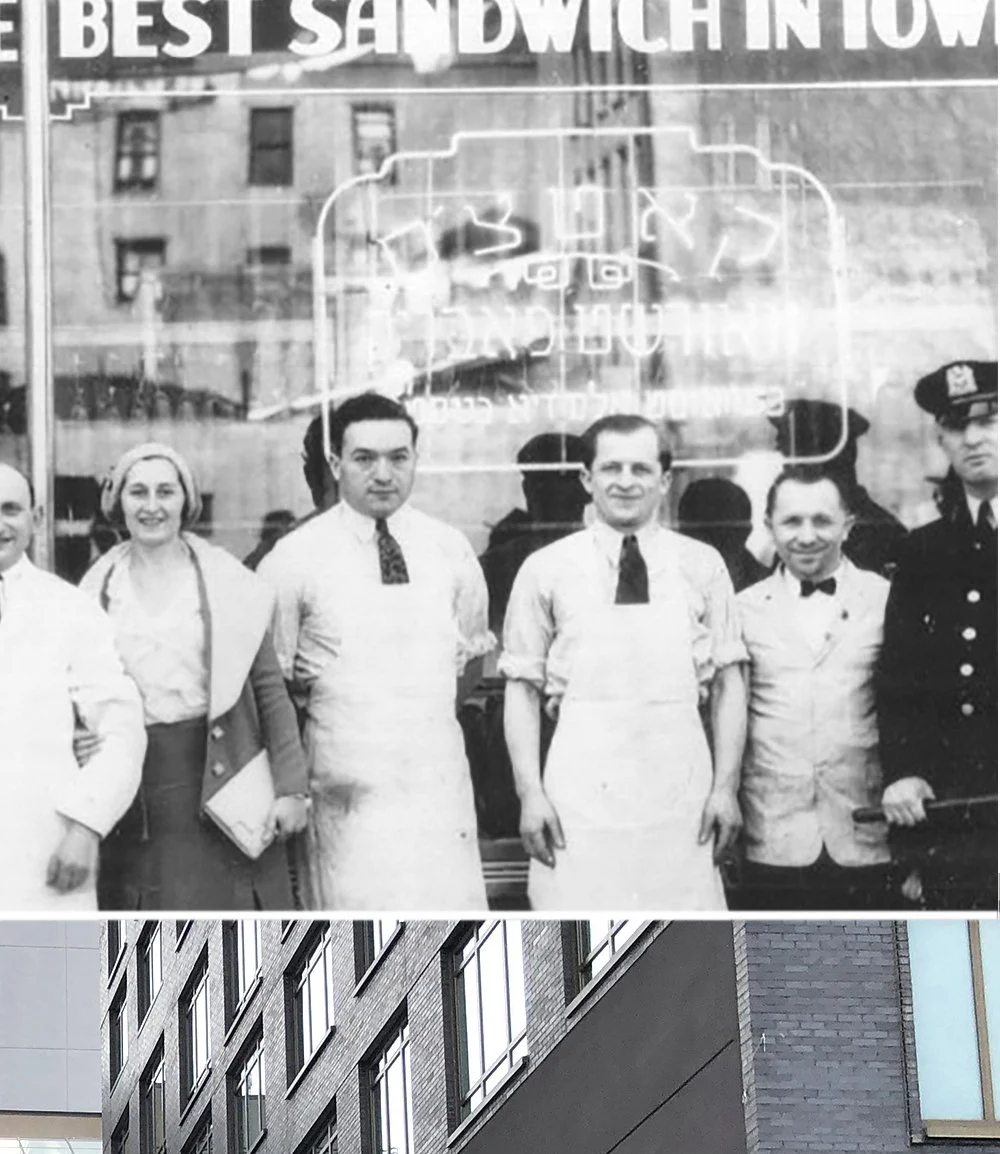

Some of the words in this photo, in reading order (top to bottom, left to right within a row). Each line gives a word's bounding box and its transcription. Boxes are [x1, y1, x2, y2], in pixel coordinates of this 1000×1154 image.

[59, 0, 253, 58] BEST
[288, 0, 722, 56] SANDWICH
[746, 0, 821, 50] IN
[842, 0, 998, 49] TOW
